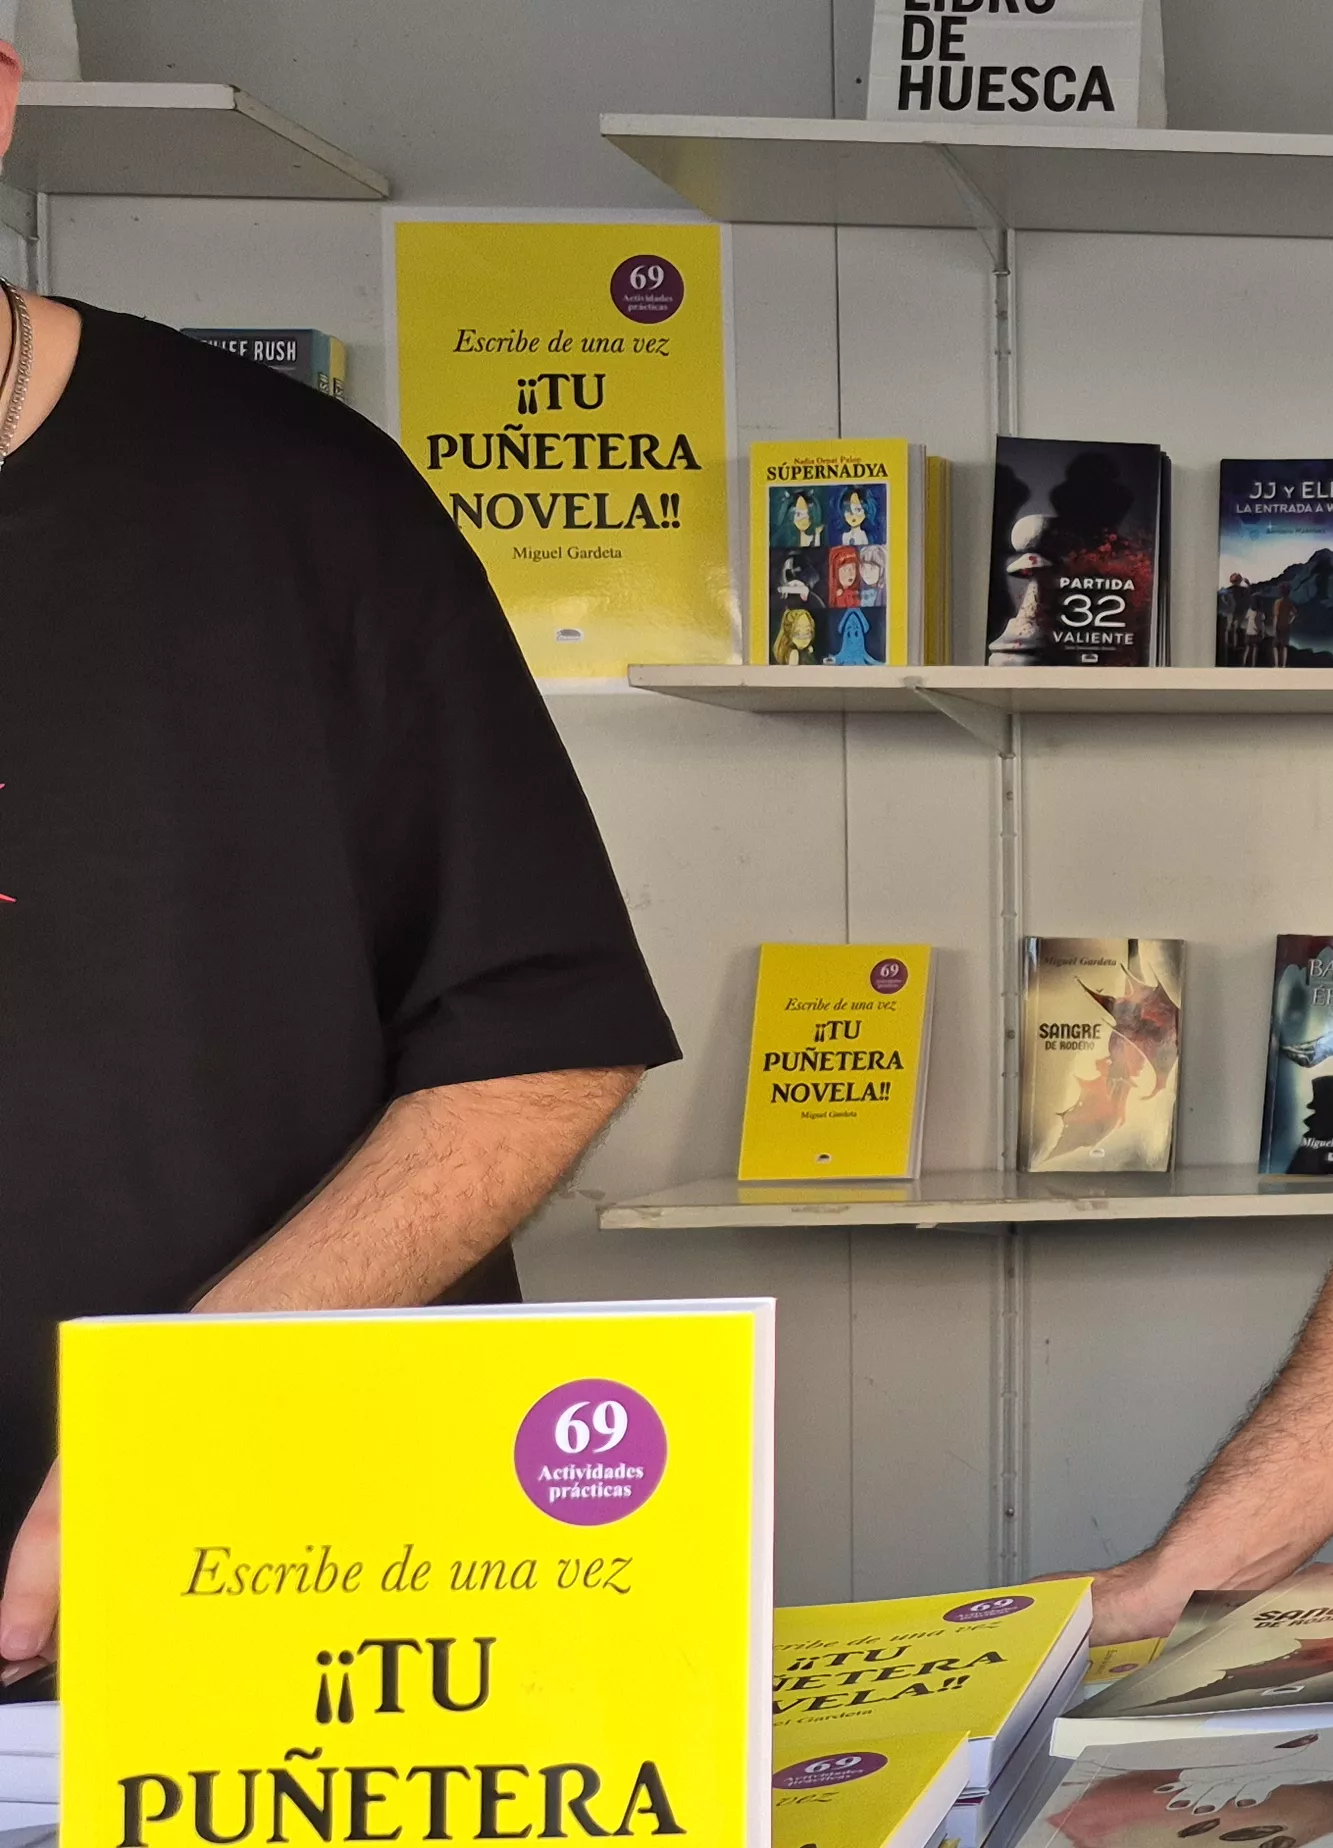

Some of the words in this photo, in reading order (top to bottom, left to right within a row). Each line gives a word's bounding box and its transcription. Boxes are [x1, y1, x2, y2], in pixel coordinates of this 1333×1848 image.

[901, 15, 967, 62] DE
[898, 65, 1115, 112] HUESCA
[630, 264, 664, 290] 69
[254, 340, 297, 361] RUSH
[453, 329, 540, 353] Escribe
[548, 330, 573, 353] de
[581, 337, 624, 353] una
[633, 338, 670, 356] vez
[517, 373, 606, 415] ¡¡TU
[427, 423, 702, 470] PUÑETERA
[766, 461, 889, 482] SÚPERNADYA
[1249, 481, 1276, 500] JJ
[450, 492, 681, 530] NOVELA!!
[1236, 503, 1253, 514] LA
[1255, 502, 1313, 514] ENTRADA
[512, 546, 562, 562] Miguel
[567, 546, 622, 560] Gardeta
[1060, 576, 1135, 592] PARTIDA
[1060, 594, 1126, 628] 32
[1052, 630, 1135, 646] VALIENTE
[879, 963, 899, 978] 69
[1079, 956, 1117, 967] Gardeta
[784, 998, 830, 1011] Escribe
[833, 998, 848, 1011] de
[851, 1001, 873, 1011] una
[877, 1001, 897, 1011] vez
[814, 1020, 862, 1042] ¡¡TU
[1039, 1022, 1102, 1040] SANGRE
[1045, 1040, 1057, 1051] DE
[1060, 1040, 1095, 1051] RODENO
[763, 1047, 904, 1072] PUÑETERA
[770, 1081, 892, 1104] NOVELA!!
[554, 1399, 629, 1457] 69
[537, 1462, 645, 1481] Actividades
[548, 1479, 633, 1502] prácticas
[180, 1543, 361, 1598] Escribe
[379, 1543, 430, 1593] de
[449, 1556, 538, 1591] una
[556, 1552, 634, 1595] vez
[970, 1598, 1014, 1612] 69
[847, 1635, 881, 1646] de
[889, 1629, 945, 1643] una
[955, 1621, 1003, 1633] vez
[786, 1644, 913, 1671] ¡¡TU
[314, 1636, 497, 1725] ¡¡TU
[804, 1756, 862, 1774] 69
[116, 1747, 687, 1848] PUÑETERA
[776, 1791, 840, 1807] vez
